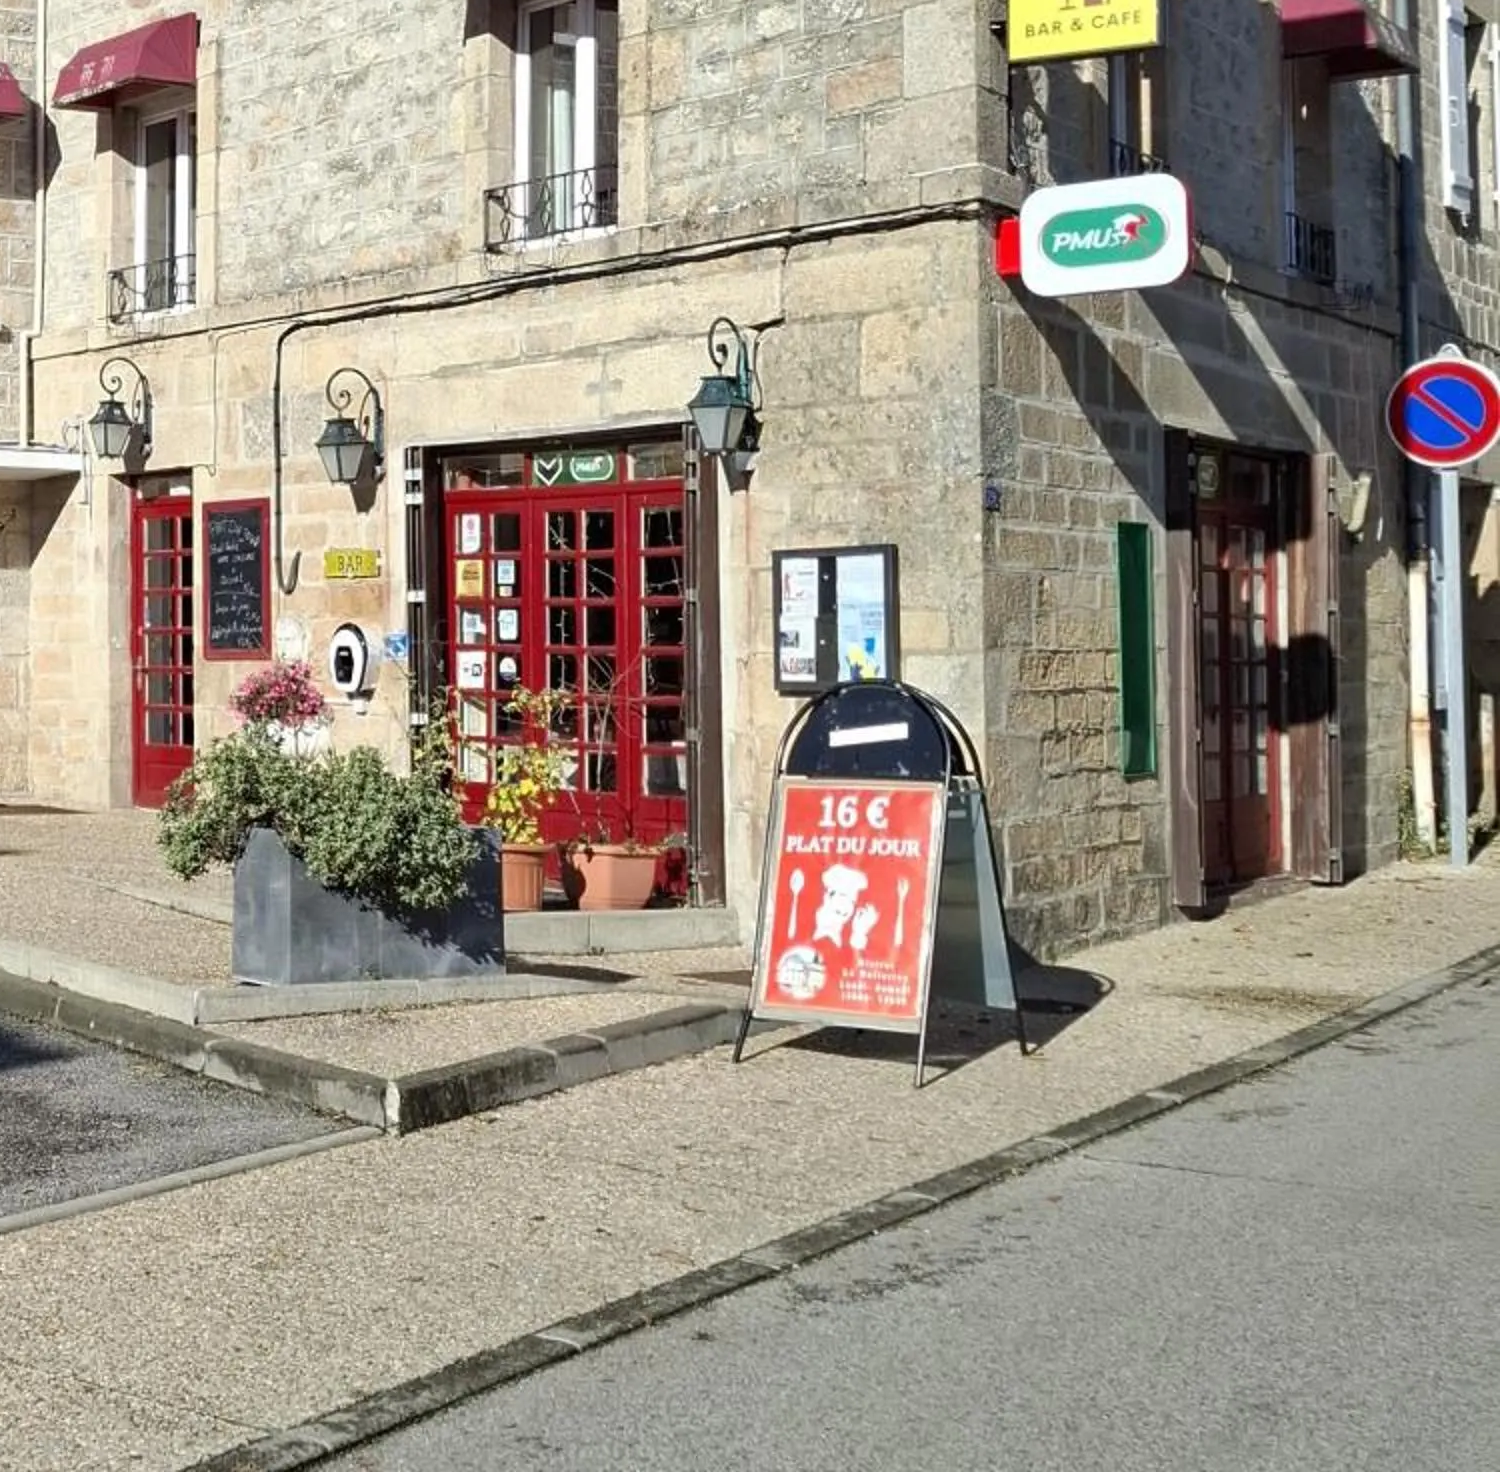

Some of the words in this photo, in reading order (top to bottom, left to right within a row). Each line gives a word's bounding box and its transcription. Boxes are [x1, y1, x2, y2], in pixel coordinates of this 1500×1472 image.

[1025, 20, 1063, 39] BAR
[1070, 17, 1084, 32] &
[1091, 9, 1142, 29] CAFE
[1051, 228, 1111, 253] PMU
[336, 554, 363, 573] BAR
[818, 794, 859, 829] 16
[866, 795, 891, 830] €
[785, 834, 835, 854] PLAT
[836, 835, 867, 856] DU
[867, 837, 921, 858] JOUR
